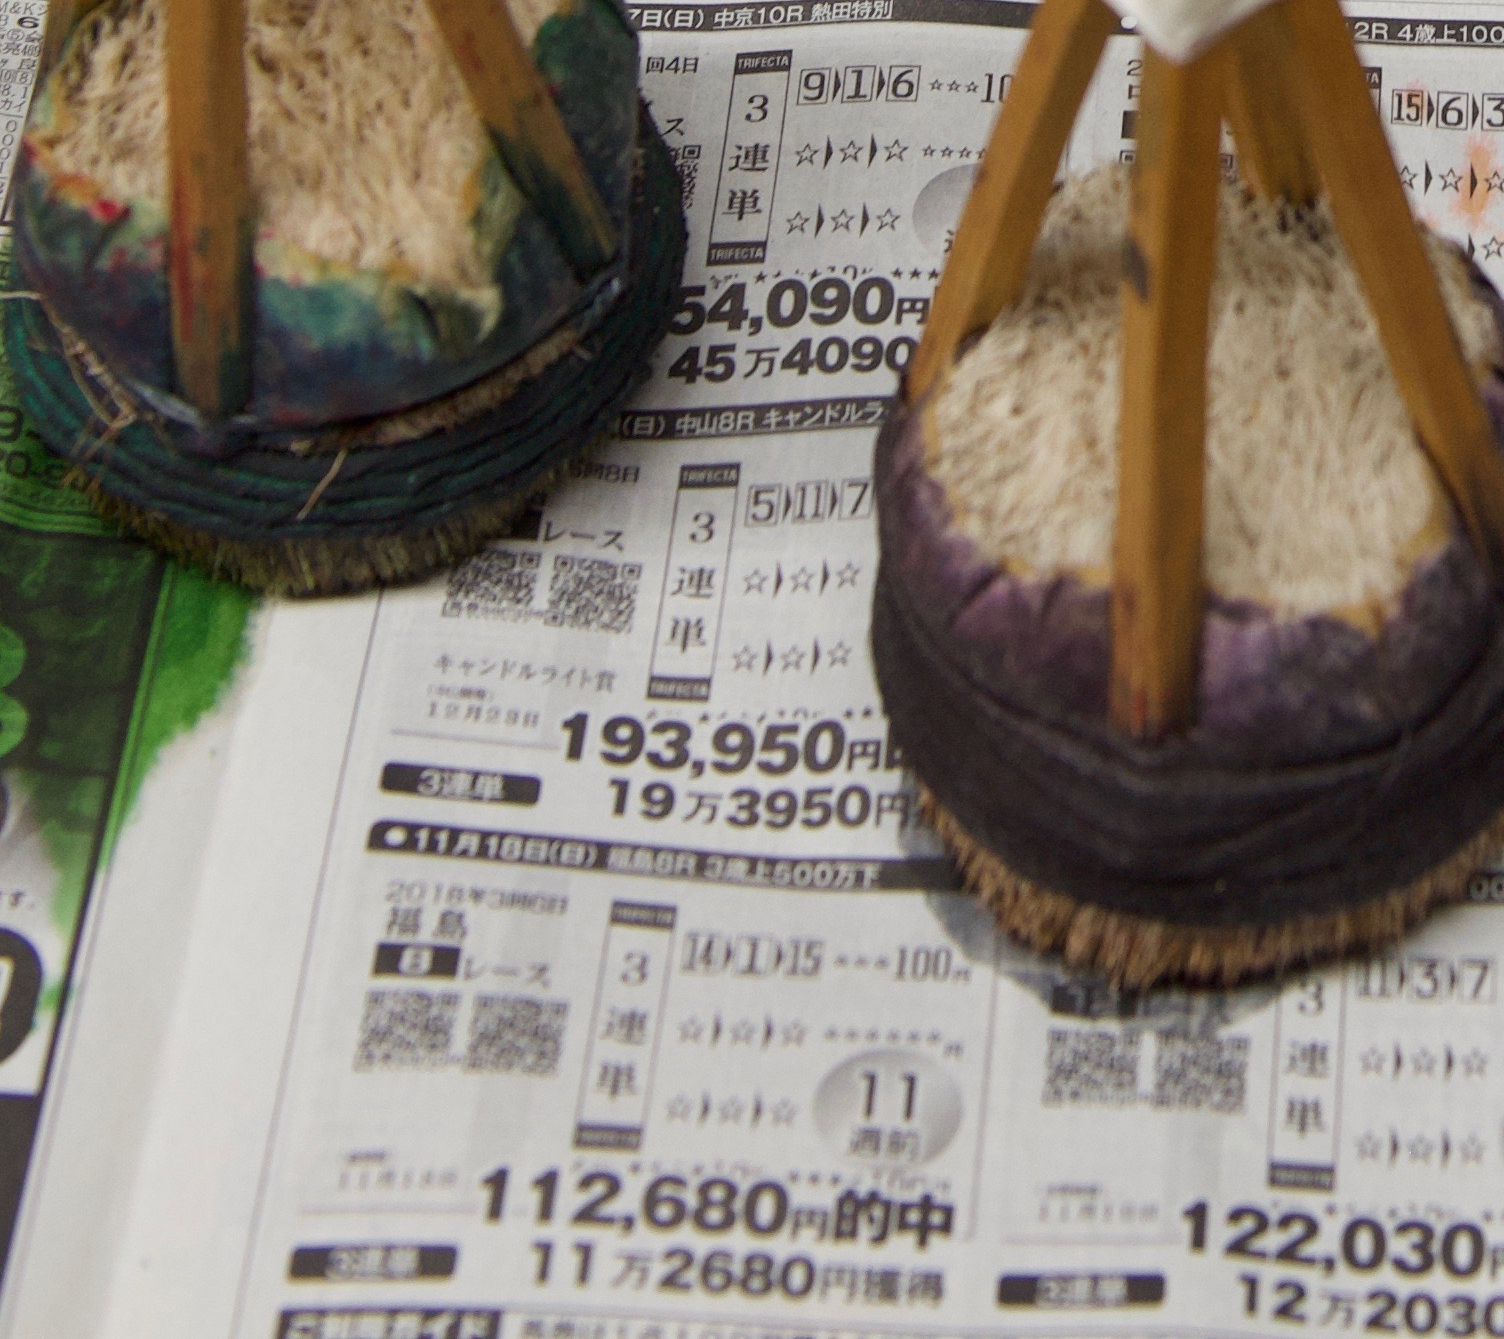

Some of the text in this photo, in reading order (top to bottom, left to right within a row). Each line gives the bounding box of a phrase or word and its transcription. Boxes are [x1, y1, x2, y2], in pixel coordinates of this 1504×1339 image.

[712, 0, 896, 29] 中京10R 熱田特別
[675, 409, 756, 436] 中山8R
[559, 711, 881, 780] 193,950円
[857, 1071, 919, 1123] 11
[479, 1164, 955, 1253] 112,680円的中
